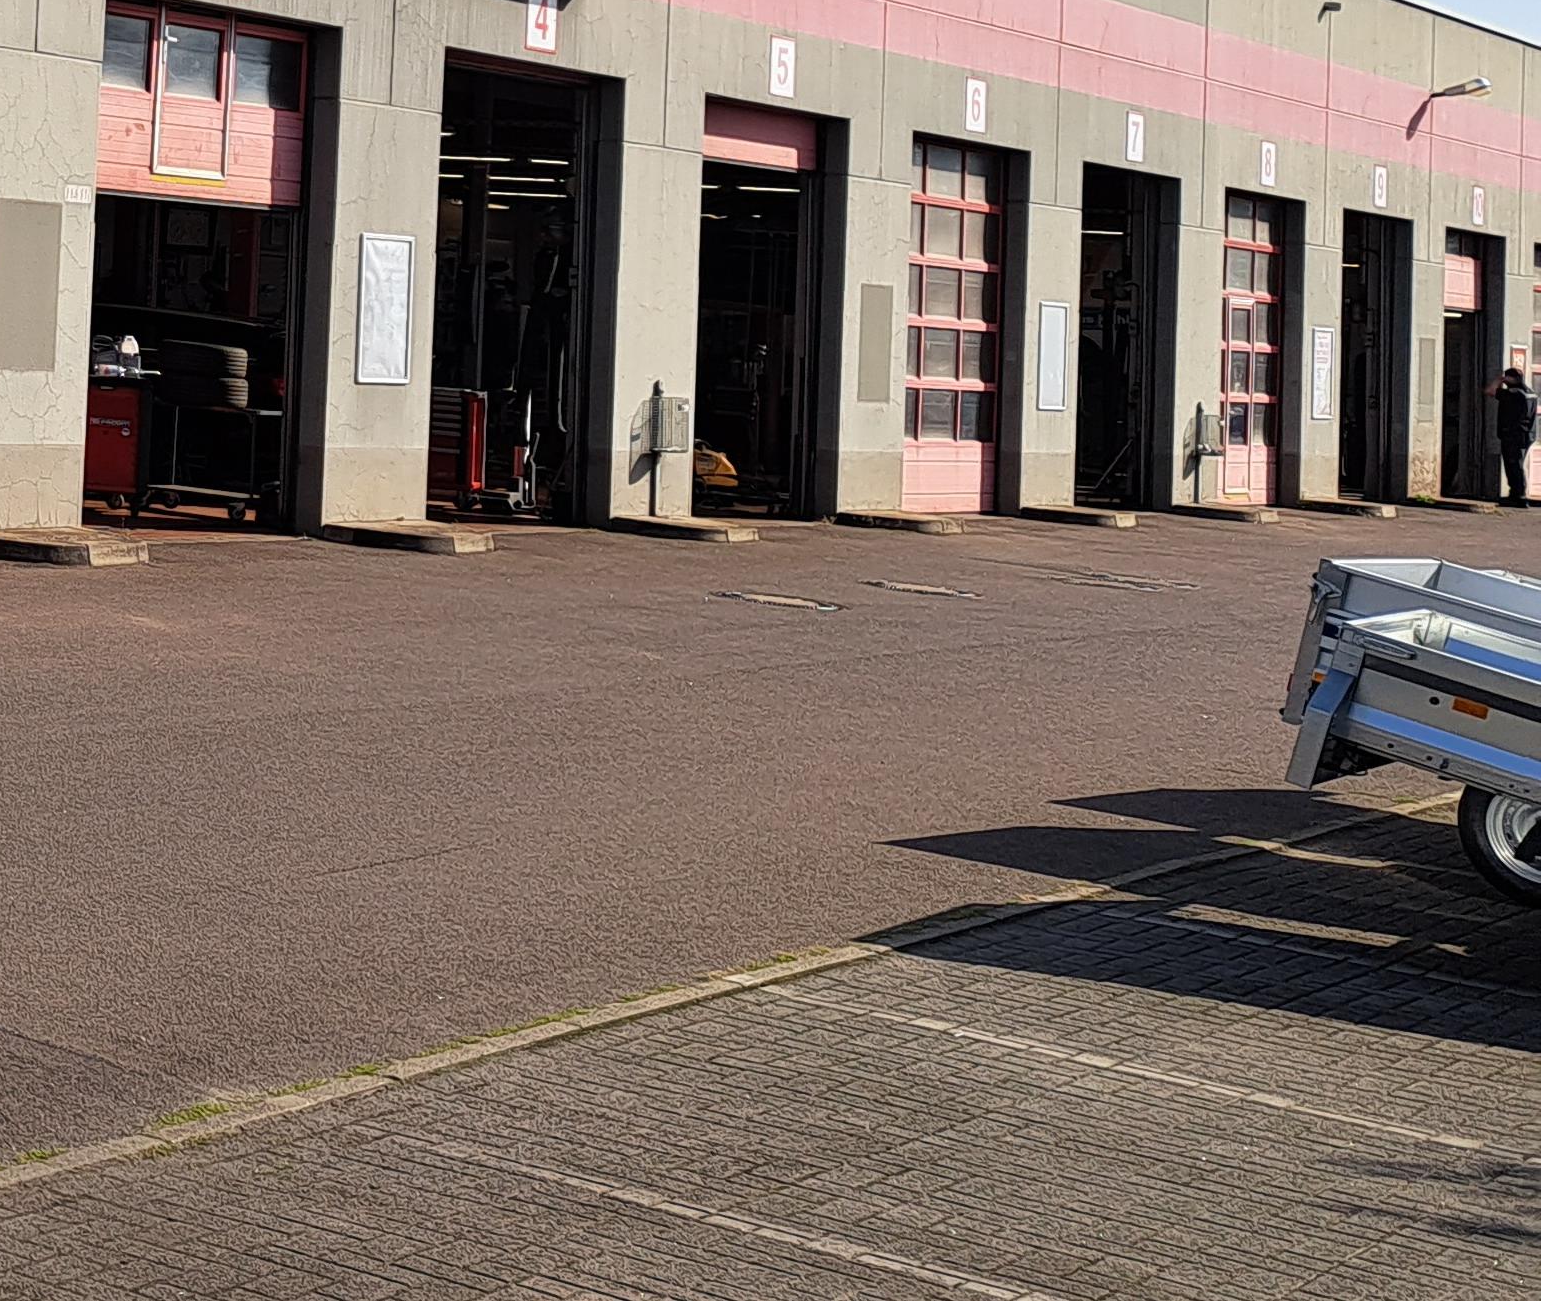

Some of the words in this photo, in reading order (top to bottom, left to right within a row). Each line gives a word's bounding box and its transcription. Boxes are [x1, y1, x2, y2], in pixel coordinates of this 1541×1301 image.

[776, 47, 789, 86] 5
[972, 87, 981, 123] 6
[1131, 120, 1140, 153] 7
[1264, 147, 1272, 178] 8
[1377, 172, 1384, 200] 9
